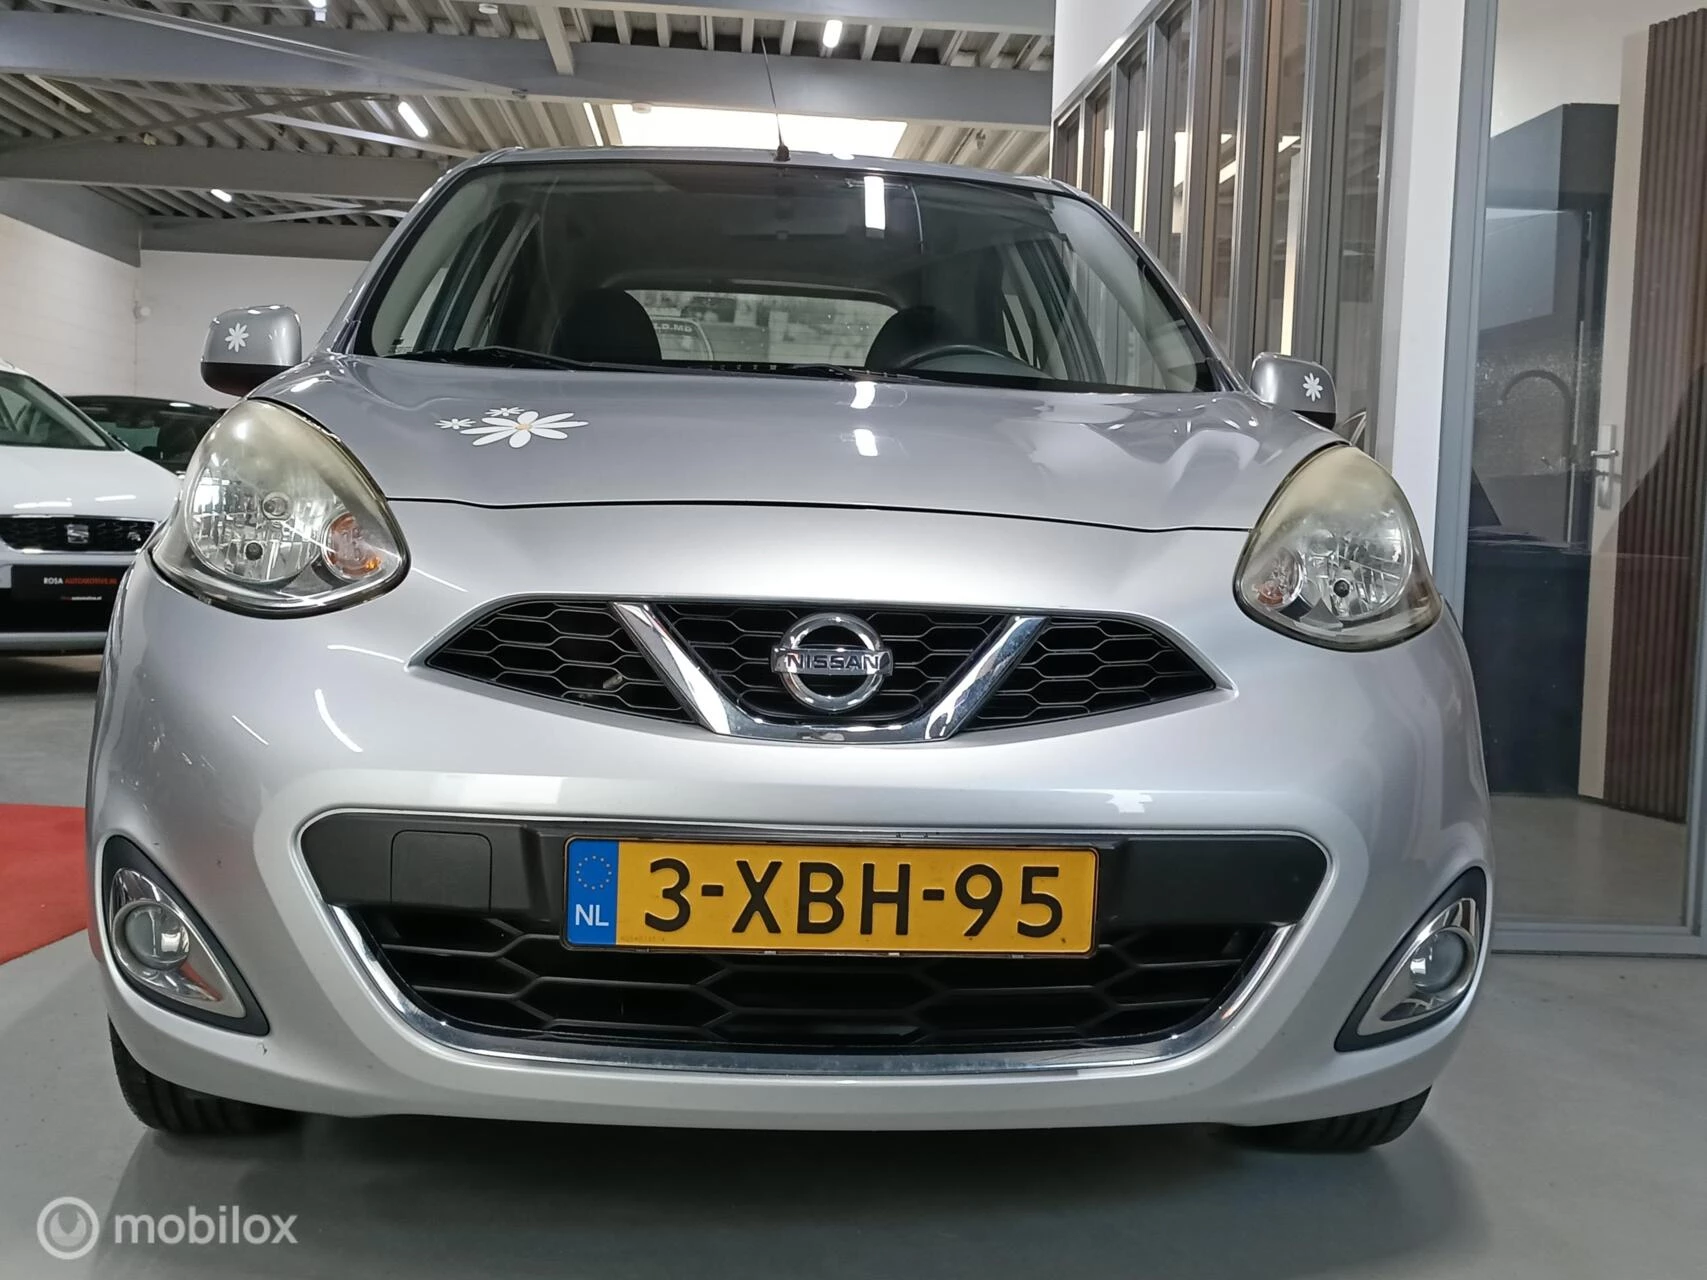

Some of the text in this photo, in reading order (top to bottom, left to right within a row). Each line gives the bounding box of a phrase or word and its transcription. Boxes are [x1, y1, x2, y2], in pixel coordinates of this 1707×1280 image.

[786, 652, 880, 670] NISSAN
[644, 857, 1063, 938] 3-XBH-95
[575, 904, 609, 926] NL
